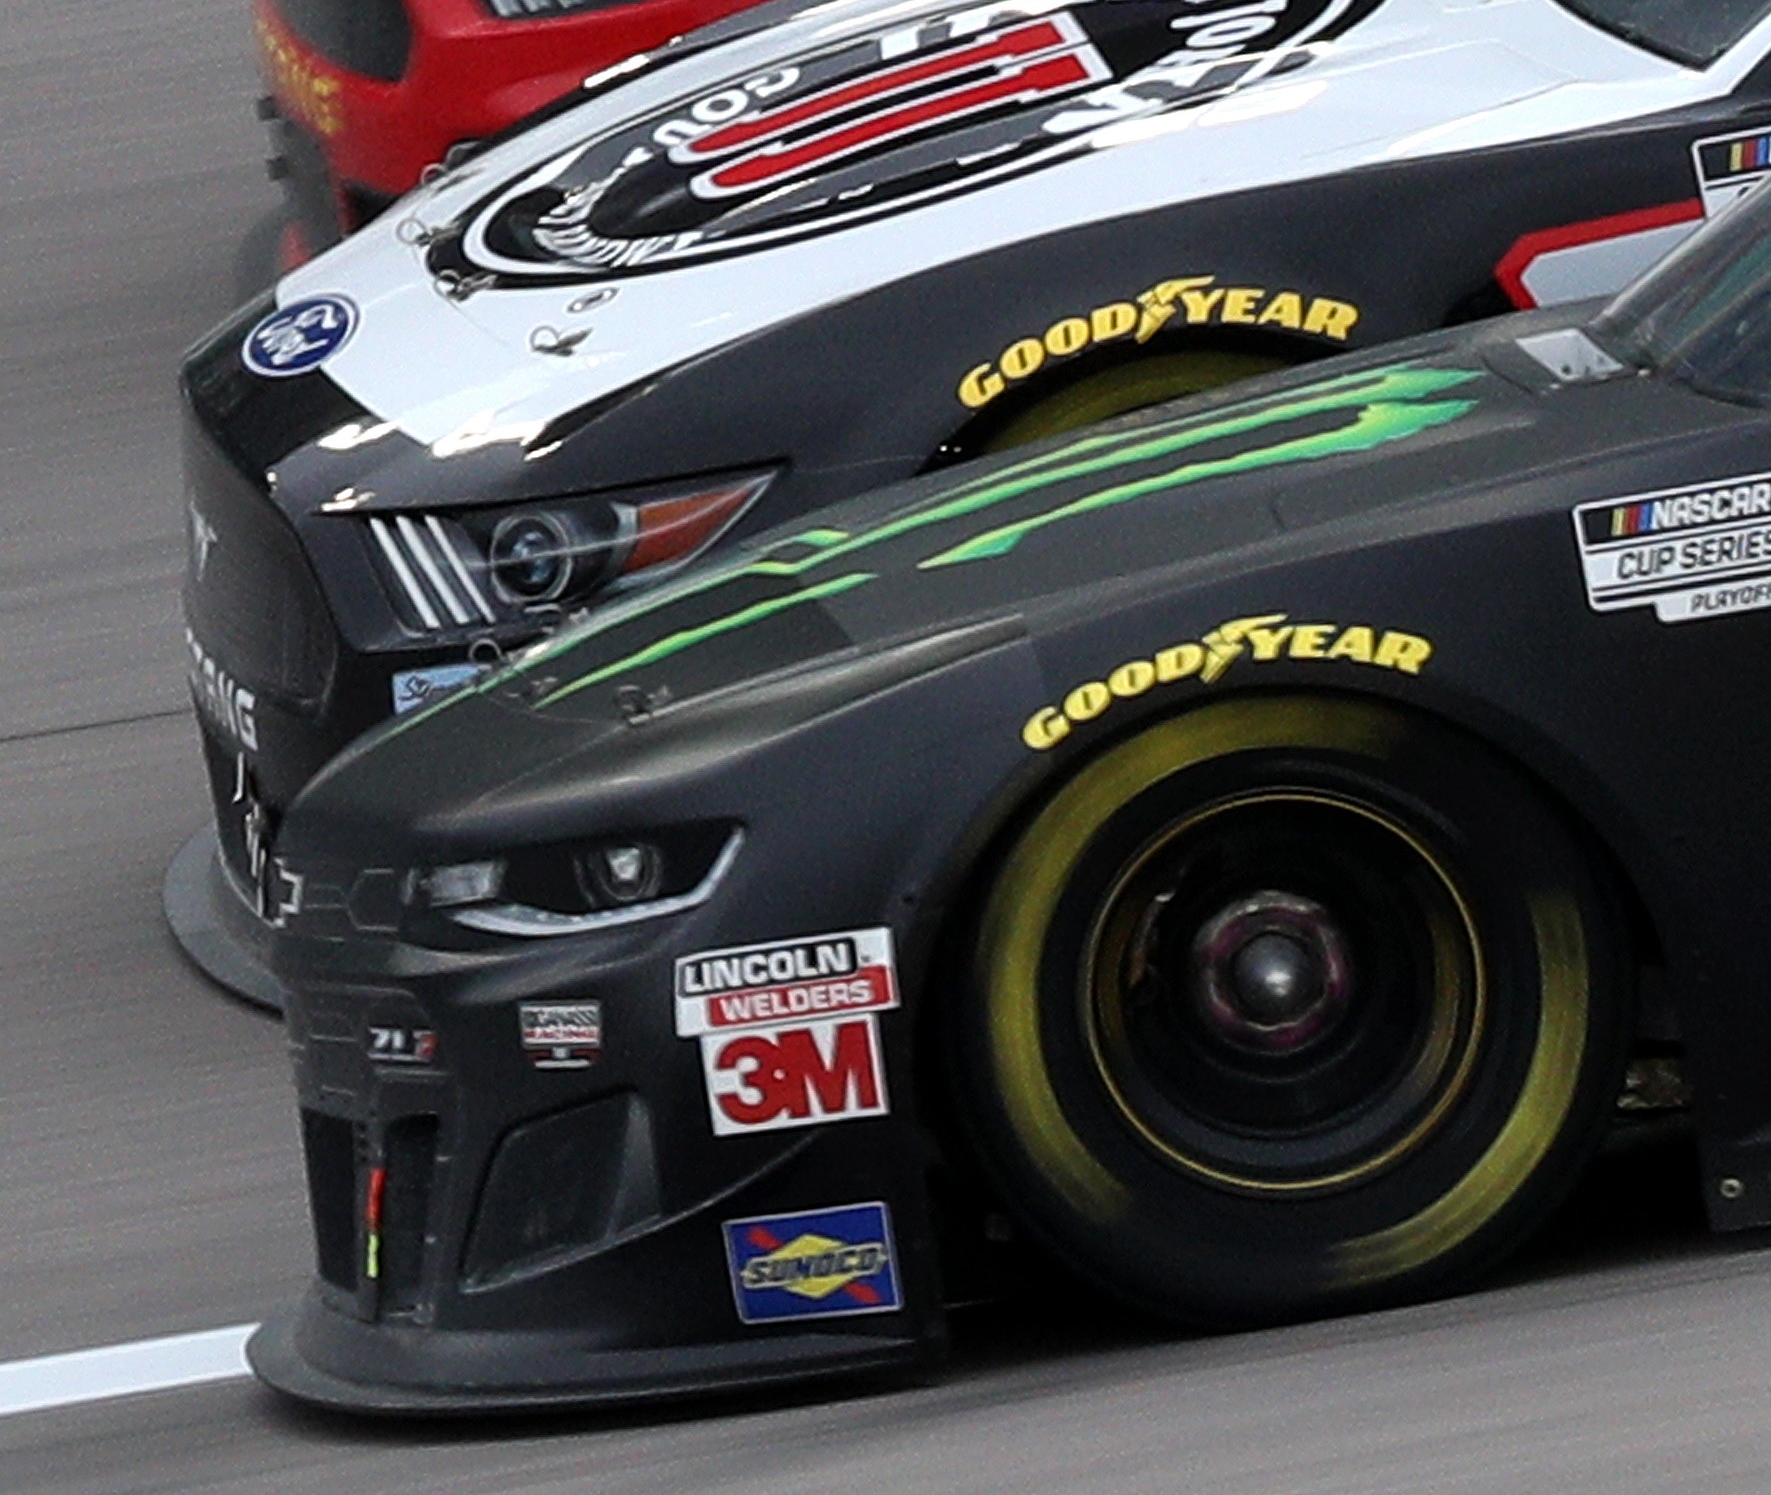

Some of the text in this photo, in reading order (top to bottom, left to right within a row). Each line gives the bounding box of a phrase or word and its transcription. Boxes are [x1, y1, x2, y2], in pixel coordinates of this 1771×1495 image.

[958, 275, 1358, 408] GOODYEAR
[1617, 544, 1676, 580] CUP
[1022, 613, 1432, 751] GOODYEAR
[684, 943, 849, 992] LINCOLN
[720, 979, 871, 1021] WELDERS
[716, 1021, 879, 1124] 3M
[745, 1247, 880, 1283] SUNOCO
